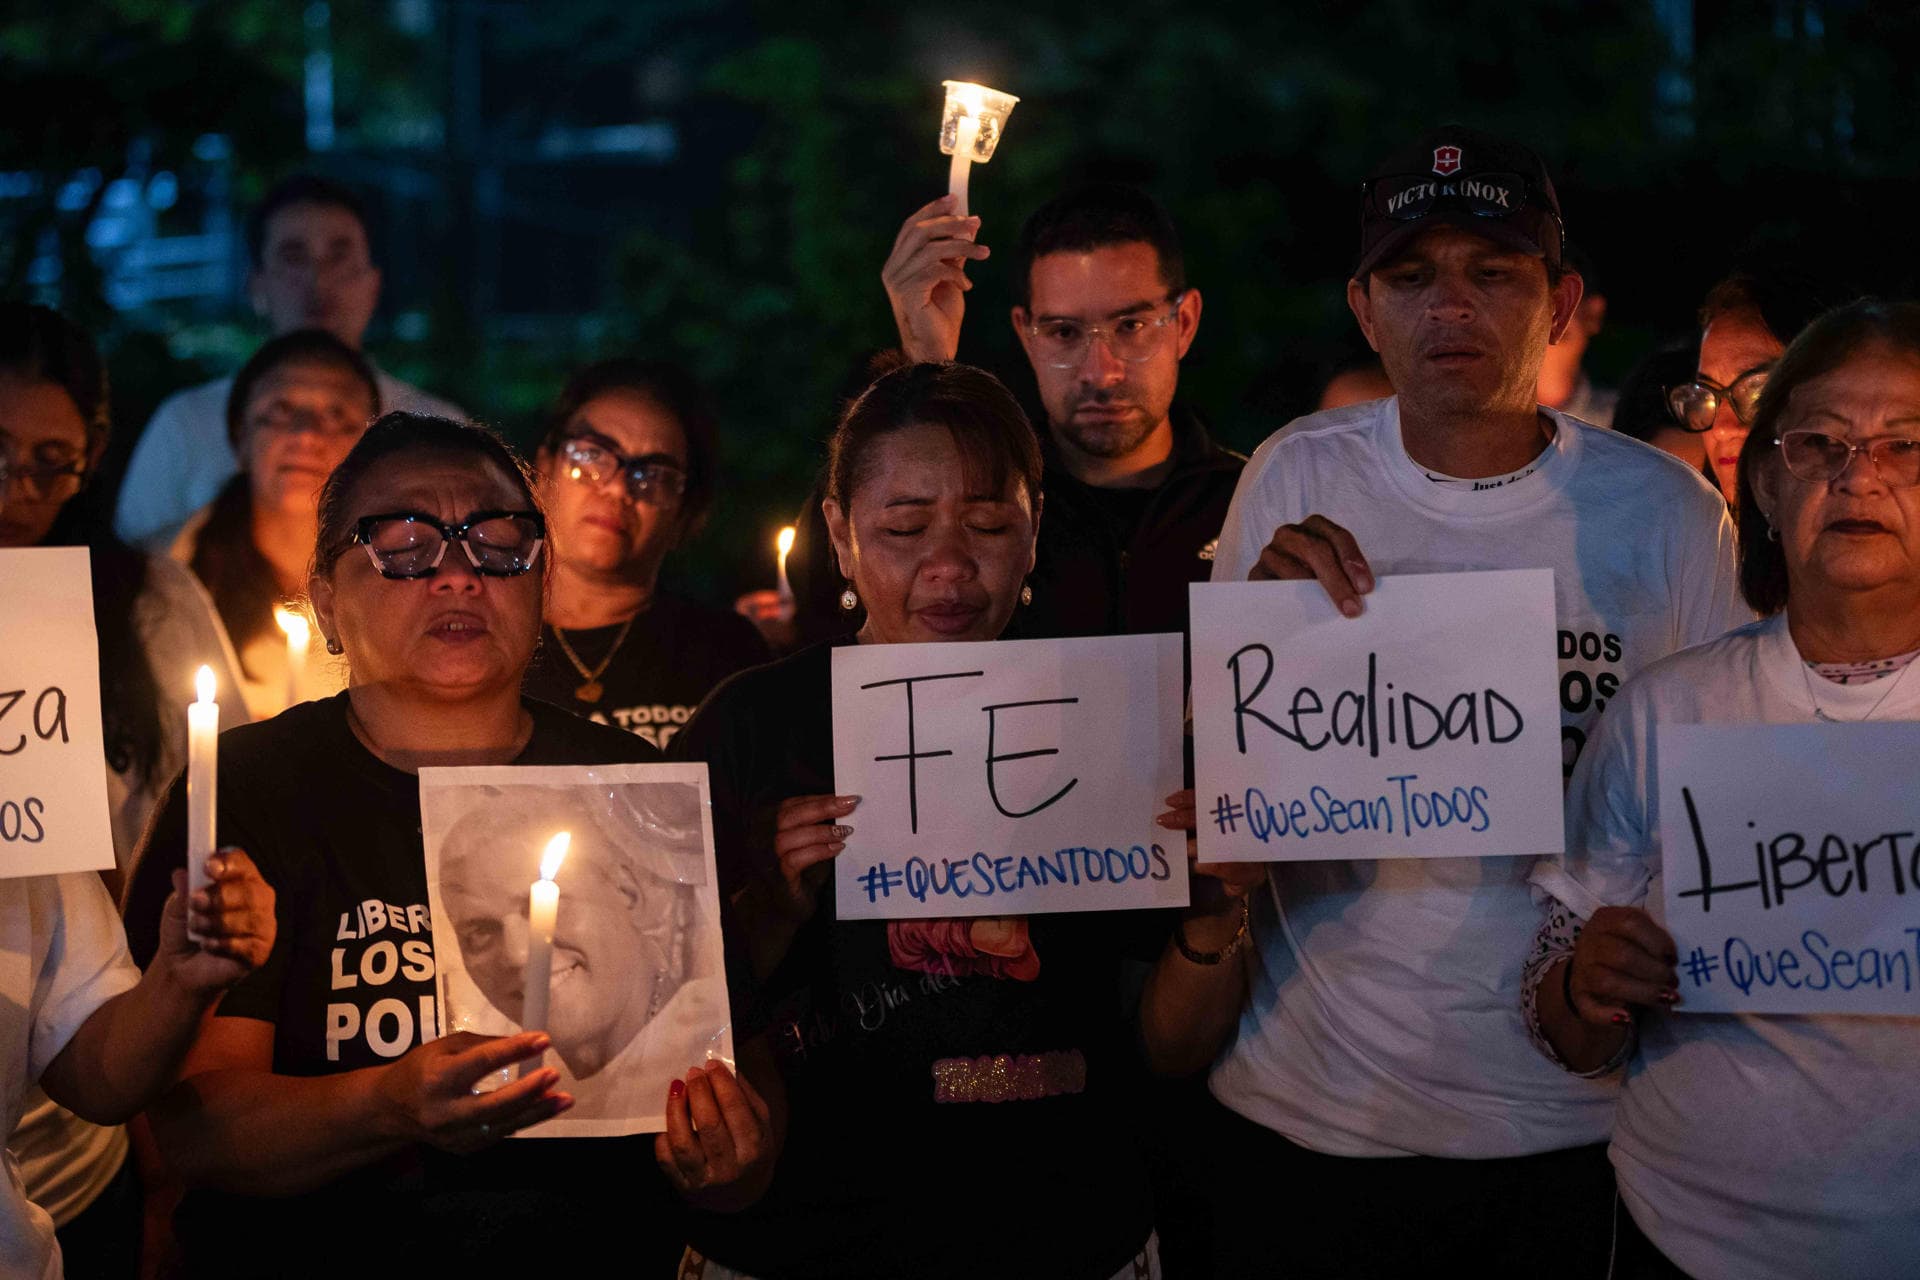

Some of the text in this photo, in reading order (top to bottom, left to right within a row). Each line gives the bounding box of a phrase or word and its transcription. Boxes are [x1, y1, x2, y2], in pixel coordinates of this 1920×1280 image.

[860, 670, 1080, 834] FE
[857, 843, 1171, 903] #QUESEANTODOS
[335, 898, 432, 942] LIBER
[330, 939, 436, 991] LOS
